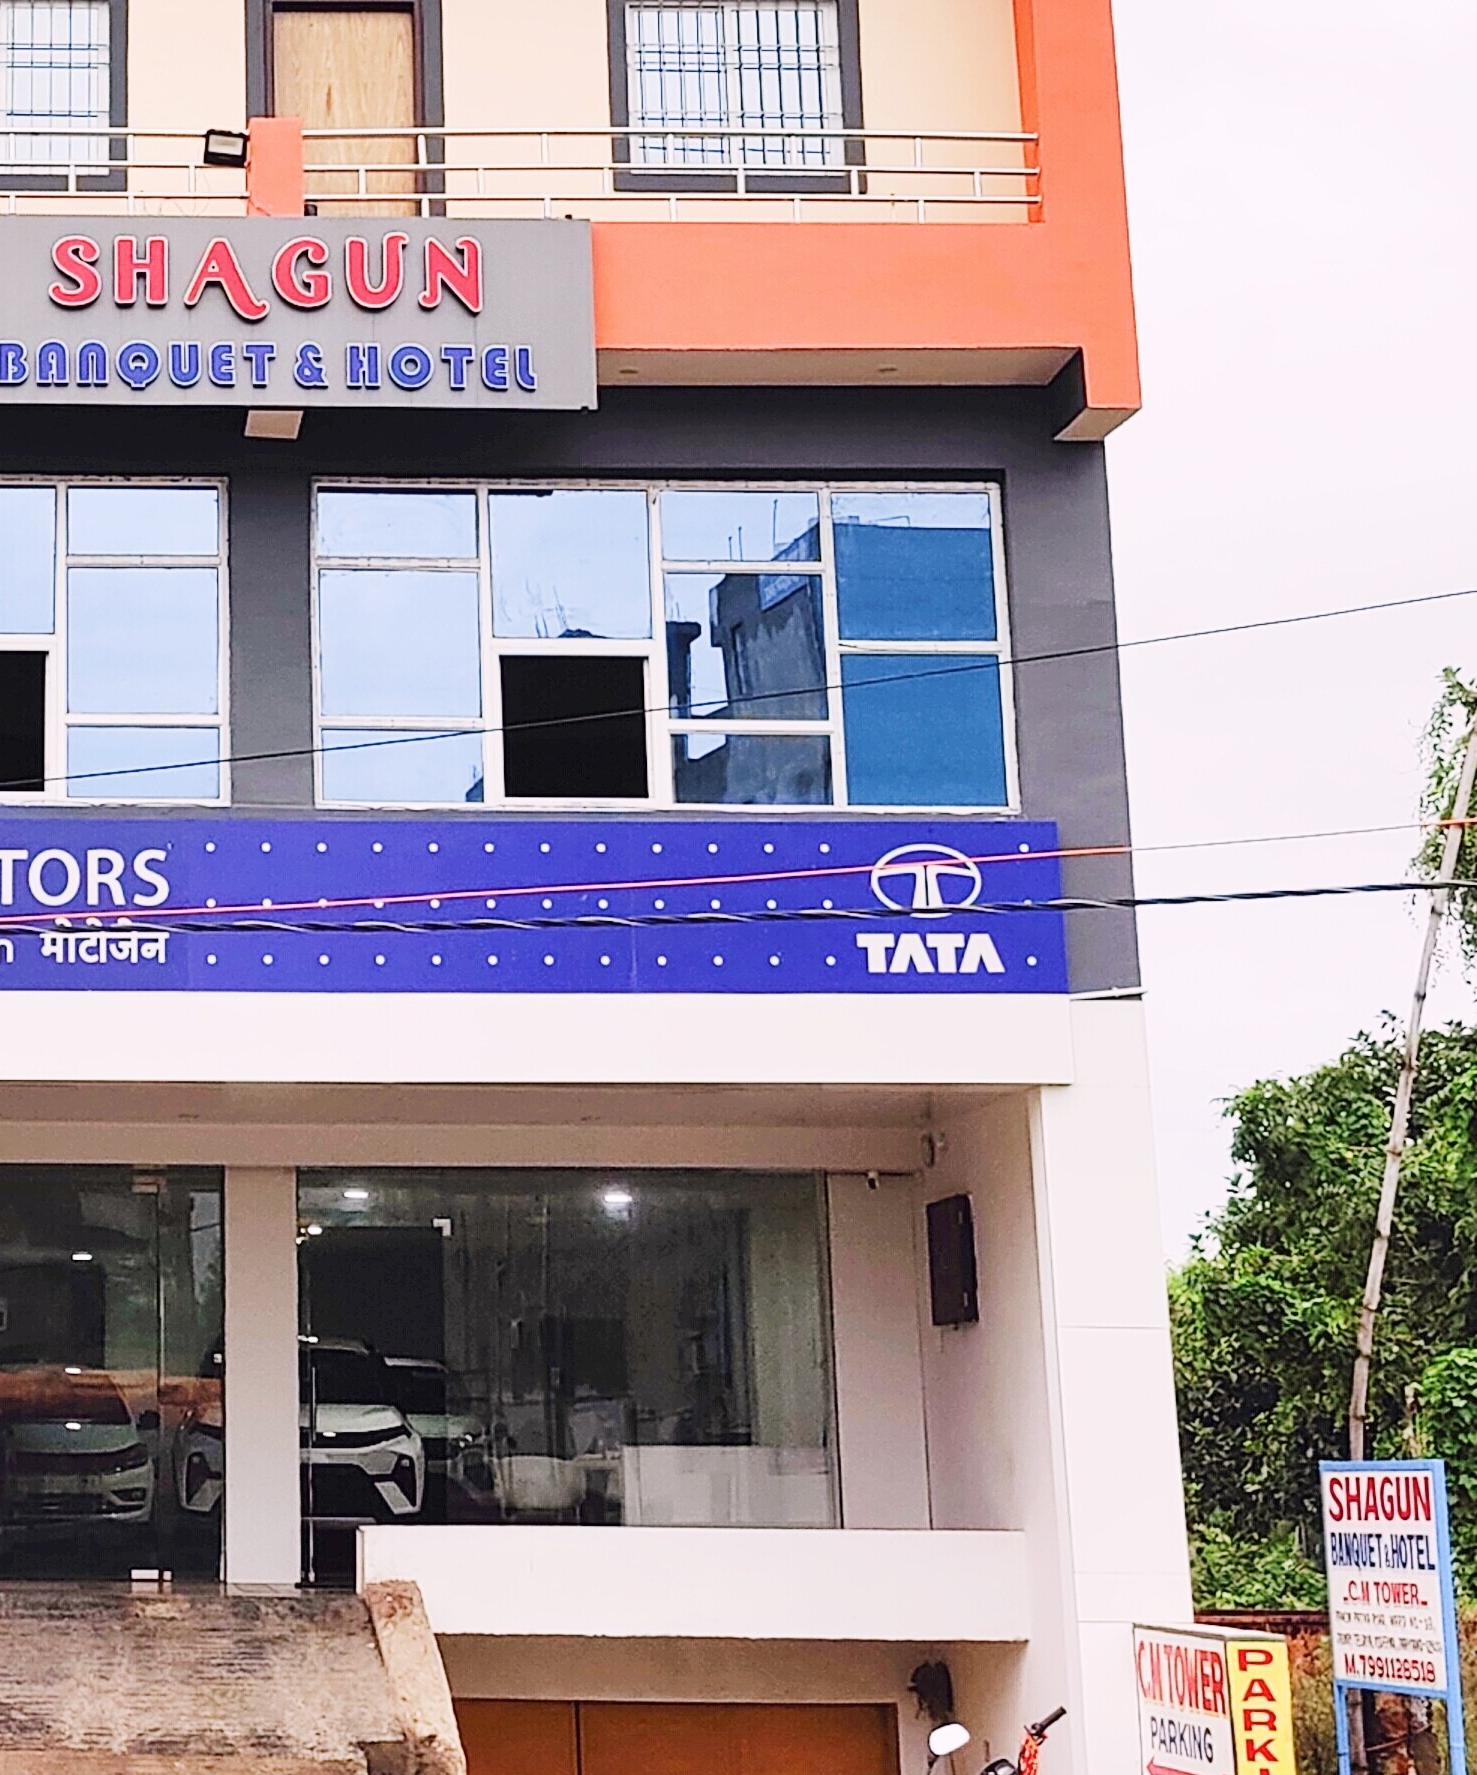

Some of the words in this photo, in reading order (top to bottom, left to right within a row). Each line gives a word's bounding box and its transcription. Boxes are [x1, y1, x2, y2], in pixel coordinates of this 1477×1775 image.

[49, 232, 484, 320] SHAGUN
[293, 341, 329, 389] &
[346, 342, 538, 390] HOTEL
[856, 933, 1005, 973] TATA
[1329, 1476, 1431, 1521] SHAGUN
[1330, 1532, 1382, 1570] BANQUET
[1390, 1534, 1435, 1570] HOTEL
[1373, 1581, 1420, 1605] TOWER
[1164, 1644, 1226, 1715] TOWER
[1344, 1653, 1436, 1683] M.7991128518
[1237, 1649, 1279, 1775] PARK
[1150, 1716, 1214, 1763] PARKING
